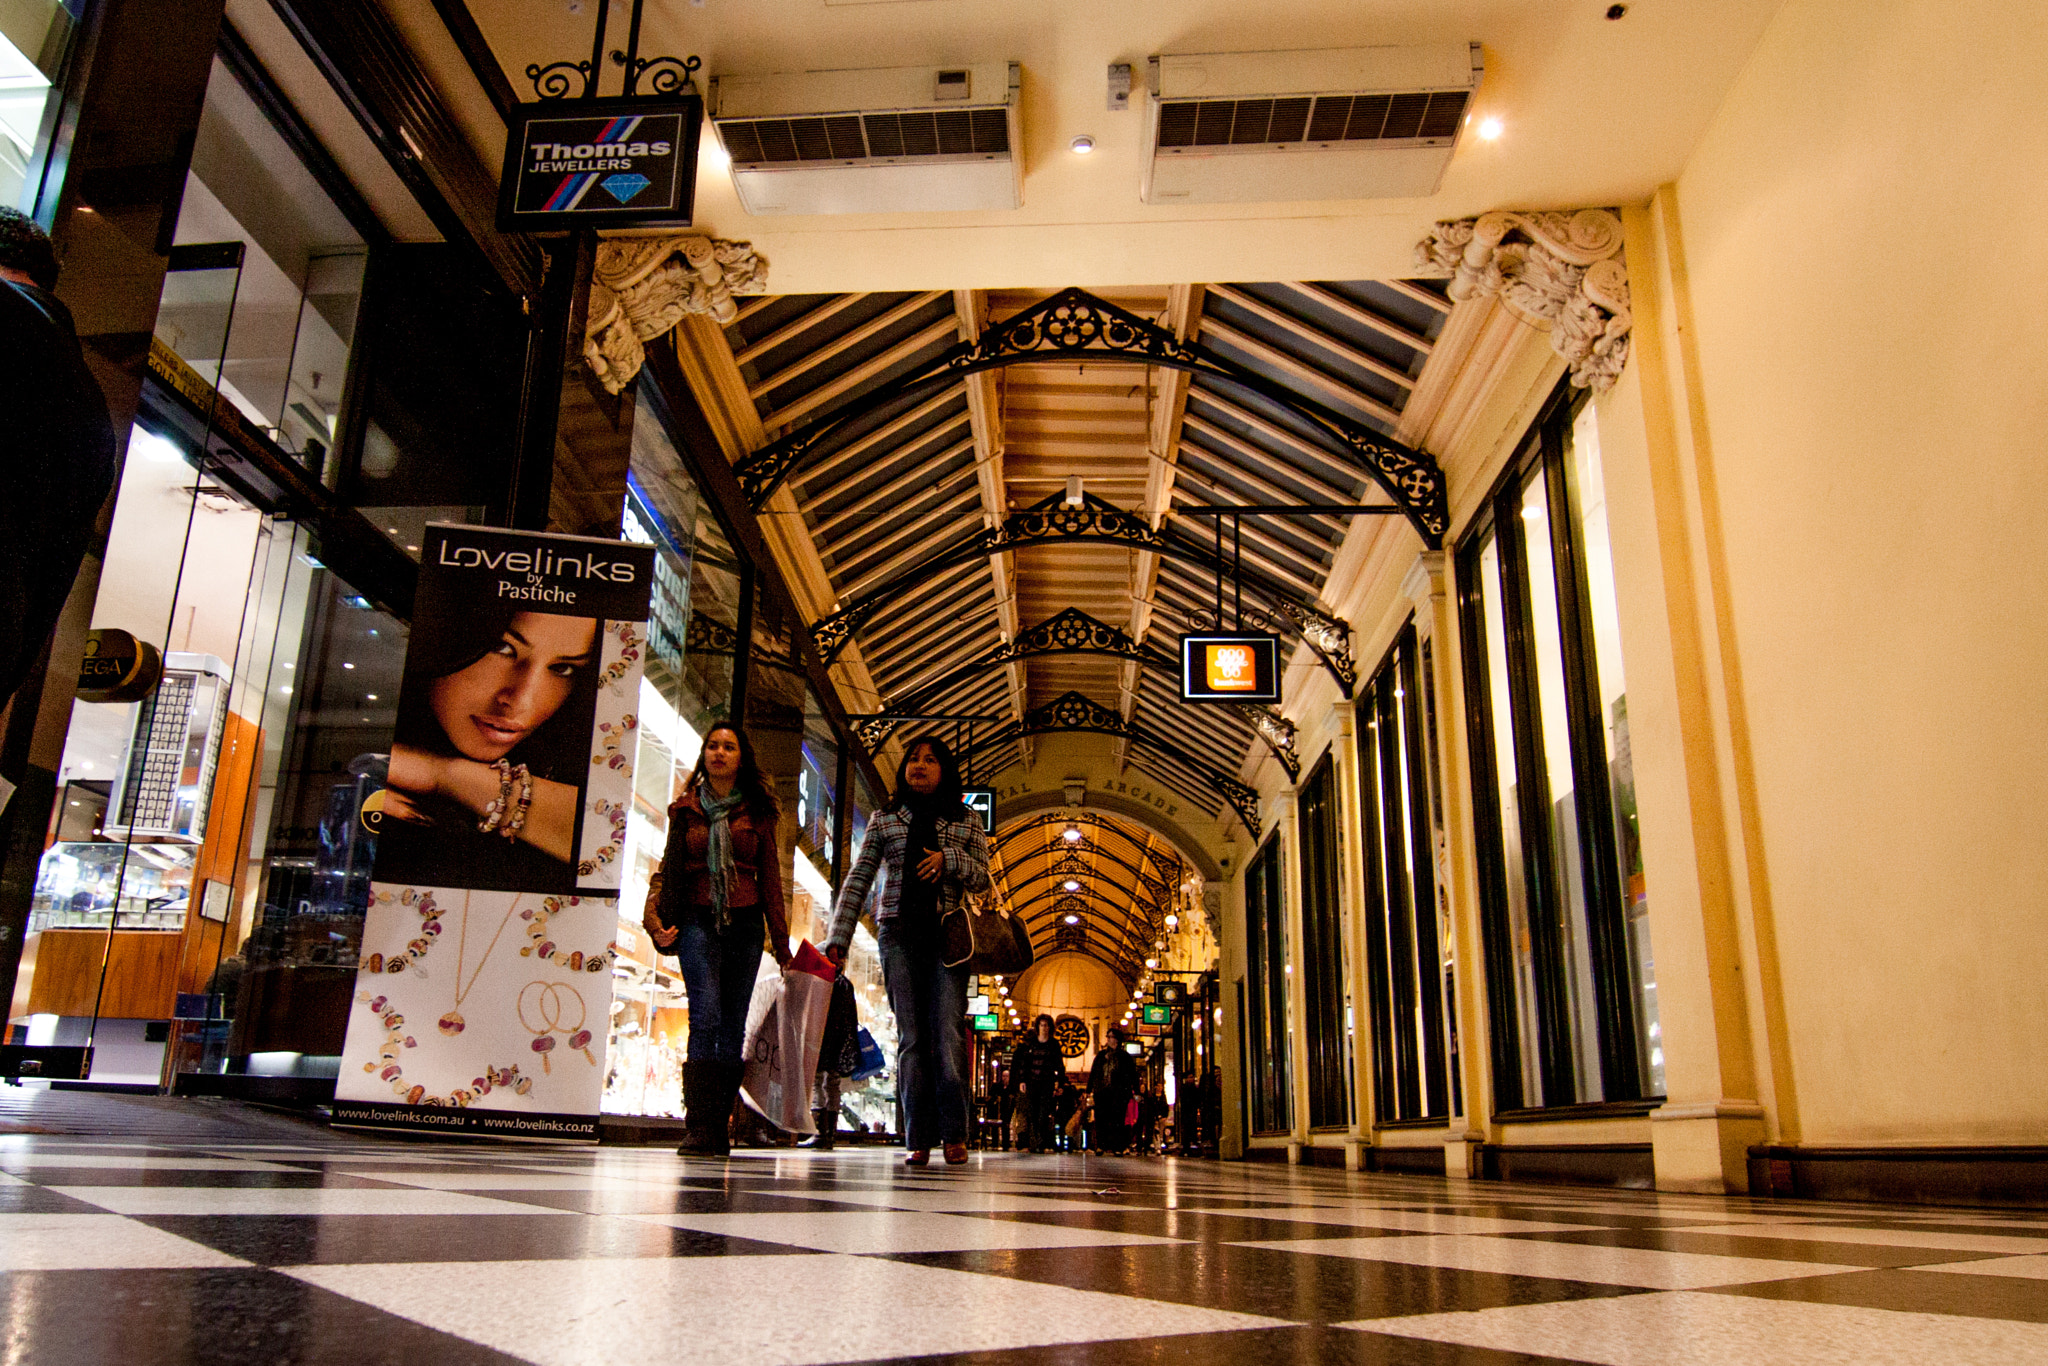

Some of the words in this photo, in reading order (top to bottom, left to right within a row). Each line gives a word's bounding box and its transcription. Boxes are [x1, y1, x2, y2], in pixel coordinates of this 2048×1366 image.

[530, 141, 671, 160] Thomas
[529, 158, 632, 173] JEWELLERS
[439, 539, 635, 583] Lovelinks
[526, 572, 543, 586] by
[498, 580, 577, 605] Pastiche
[81, 659, 121, 675] EGA
[1103, 779, 1178, 816] ARCADE
[338, 1108, 464, 1126] www.lovelinks.com.au
[484, 1118, 594, 1133] www.lovelinks.co.nz
